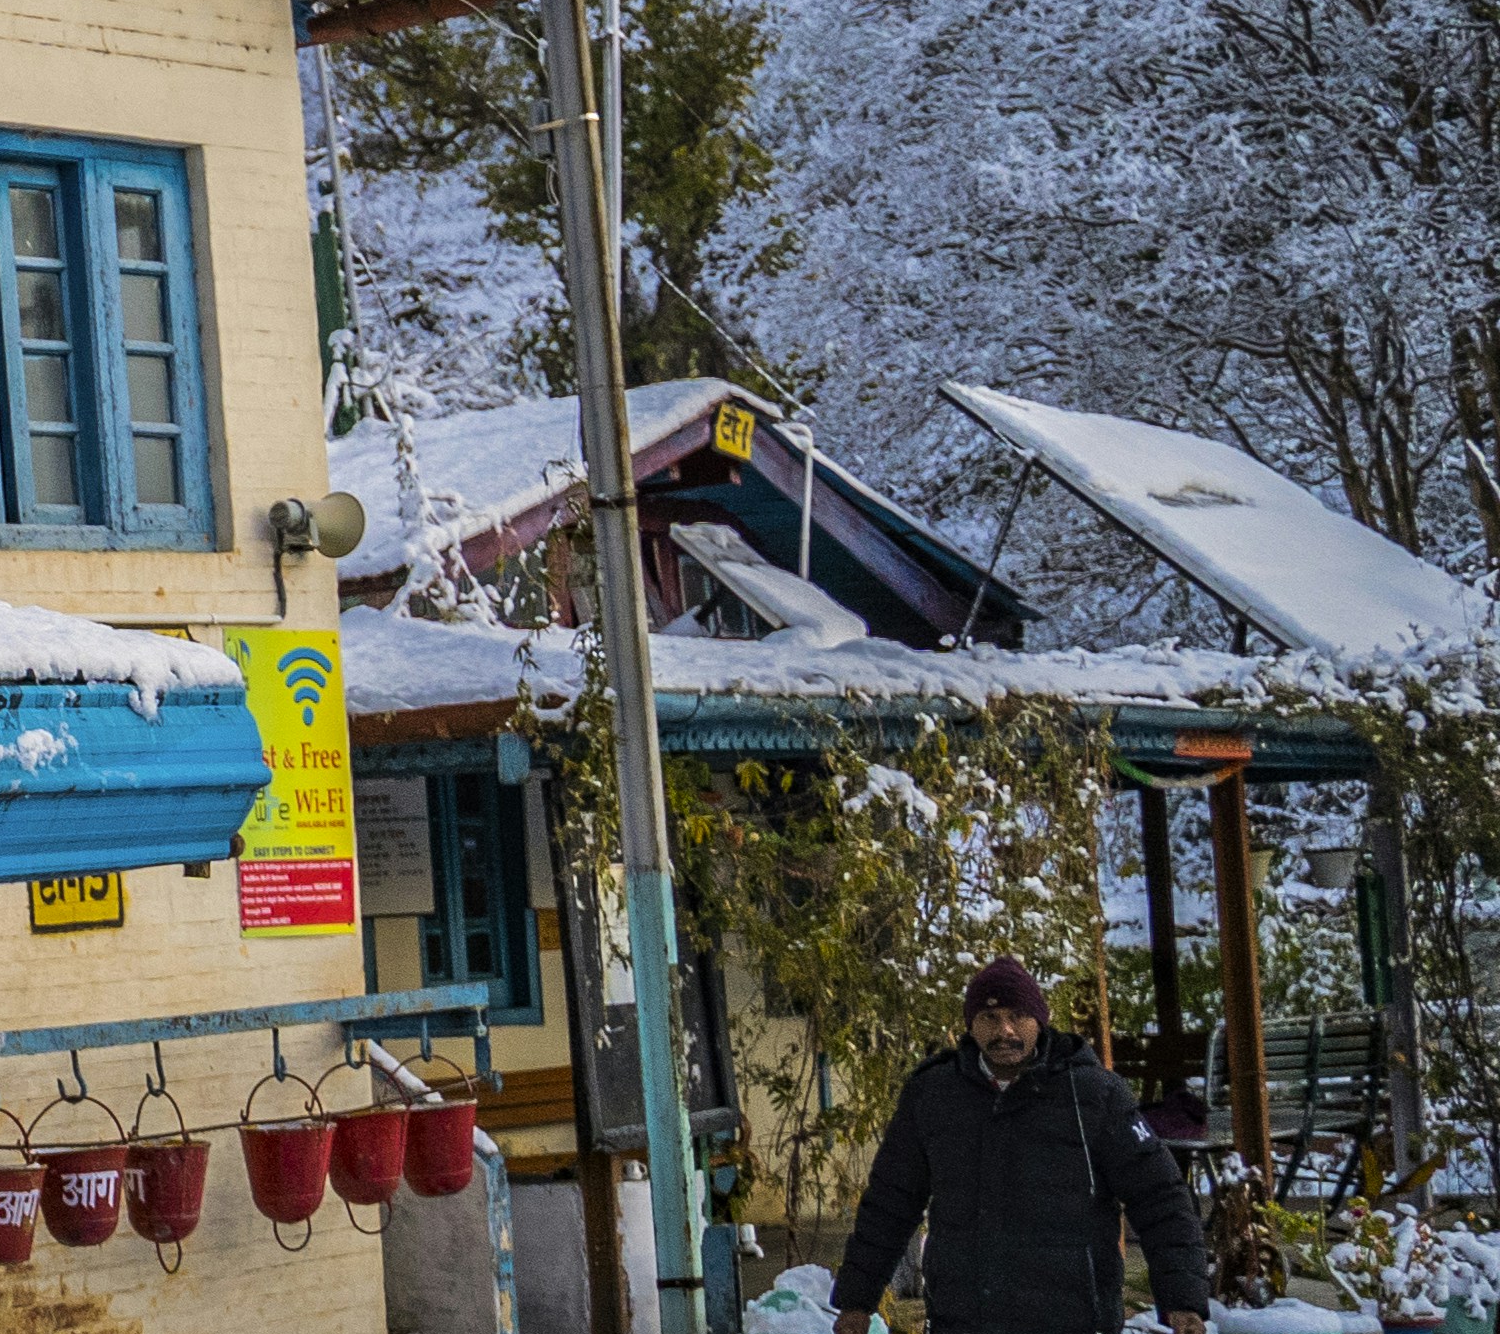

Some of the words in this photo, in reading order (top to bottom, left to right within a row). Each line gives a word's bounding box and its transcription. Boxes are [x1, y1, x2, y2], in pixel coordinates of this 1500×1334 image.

[283, 748, 295, 769] &
[300, 741, 342, 769] Free
[295, 788, 345, 814] Wi-Fi
